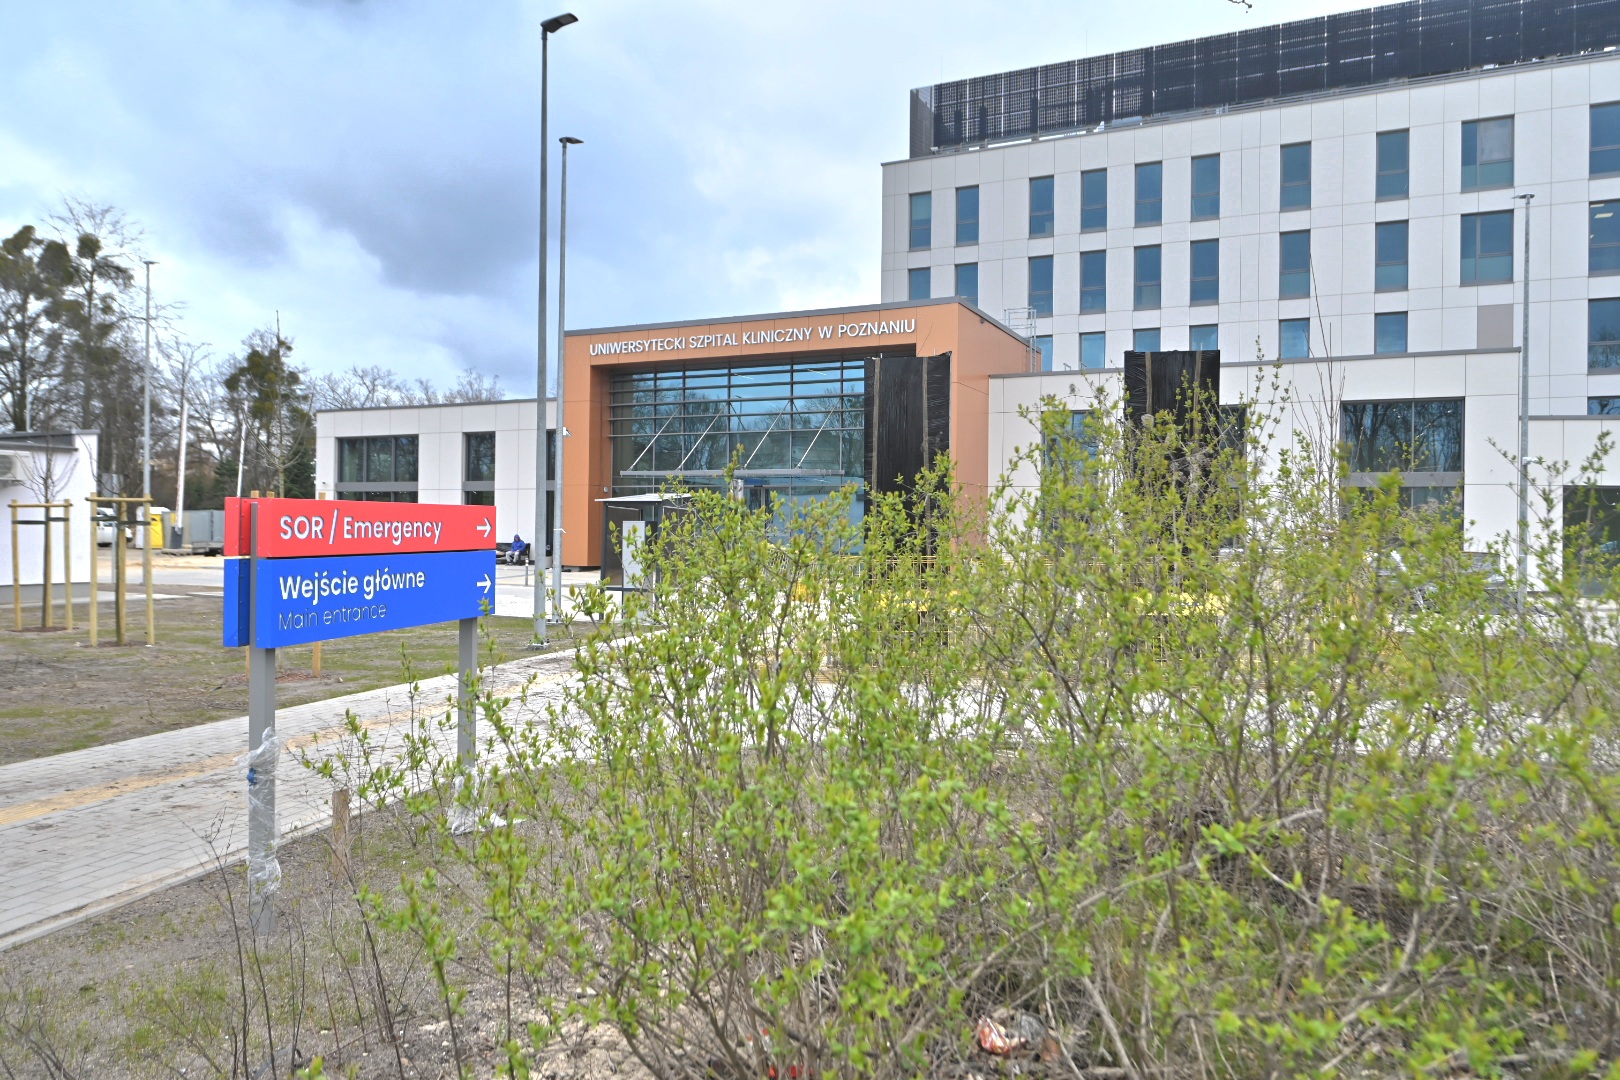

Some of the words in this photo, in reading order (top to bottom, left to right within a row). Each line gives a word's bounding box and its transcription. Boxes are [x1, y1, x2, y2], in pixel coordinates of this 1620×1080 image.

[590, 337, 686, 356] UNIWERSYTECKI
[689, 333, 738, 349] SZPITAL
[742, 327, 813, 345] KLINICZNY
[818, 326, 834, 339] W
[838, 318, 917, 338] POZNANIU
[280, 515, 324, 540] SOR
[329, 509, 338, 544] /
[343, 516, 442, 545] Emergency
[279, 570, 359, 605] Wejście
[363, 567, 426, 600] główne
[279, 609, 318, 630] Main
[323, 603, 387, 625] entrance
